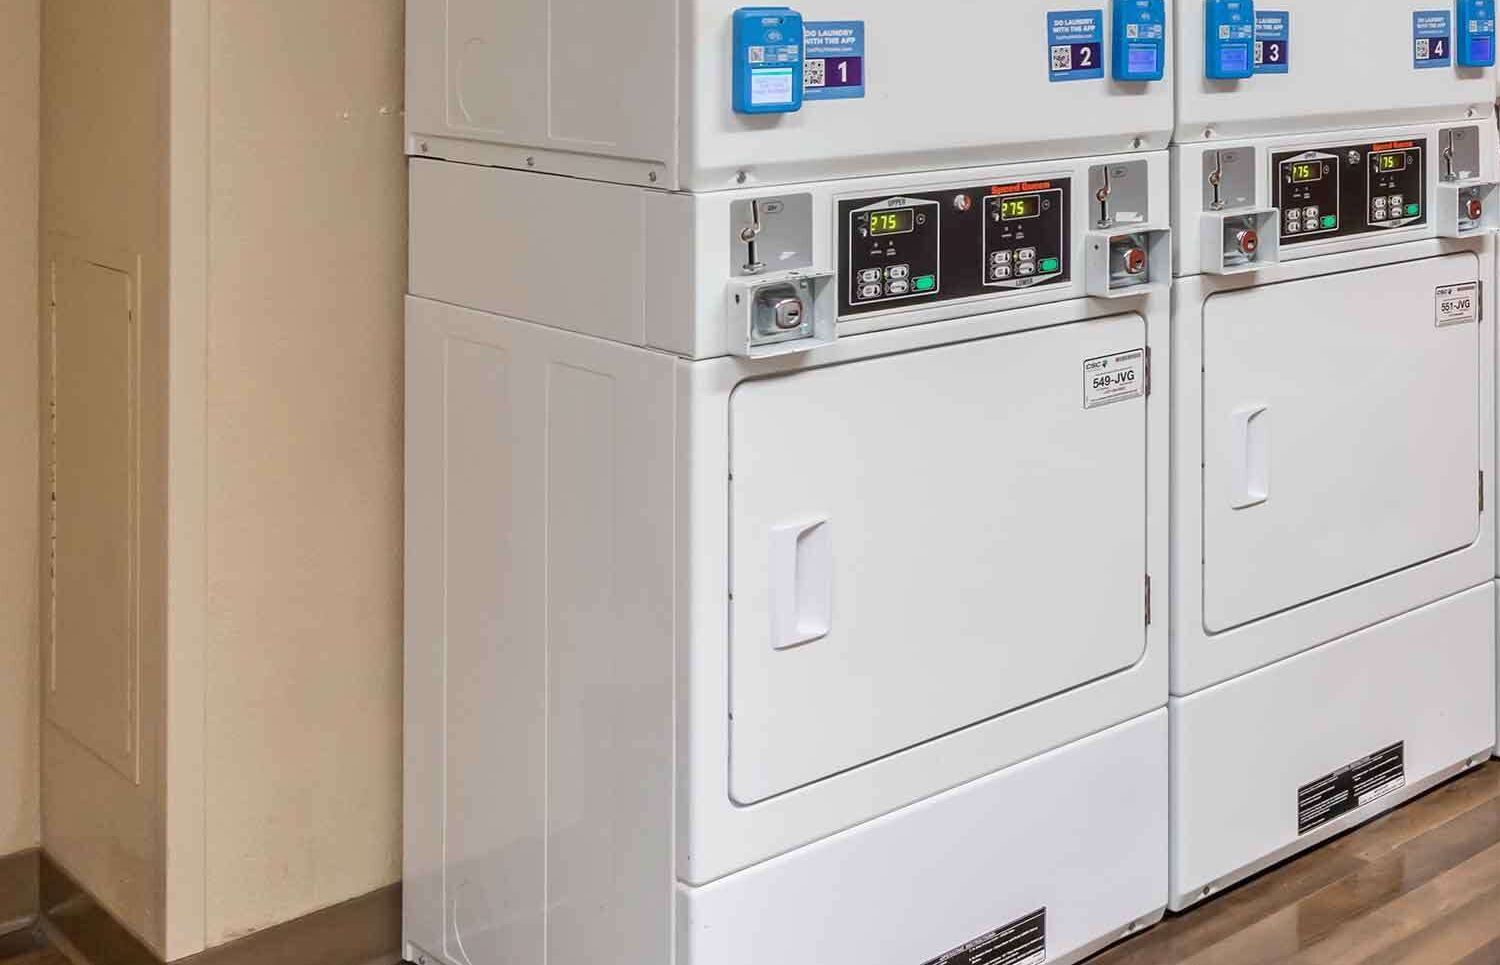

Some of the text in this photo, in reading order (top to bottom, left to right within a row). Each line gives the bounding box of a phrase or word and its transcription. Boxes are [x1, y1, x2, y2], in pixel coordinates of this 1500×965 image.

[1080, 46, 1092, 66] 2
[1269, 44, 1279, 62] 3
[1434, 40, 1443, 57] 4
[837, 61, 848, 83] 1
[1441, 299, 1471, 312] 551-JVG
[1092, 370, 1135, 389] 549-JVG
